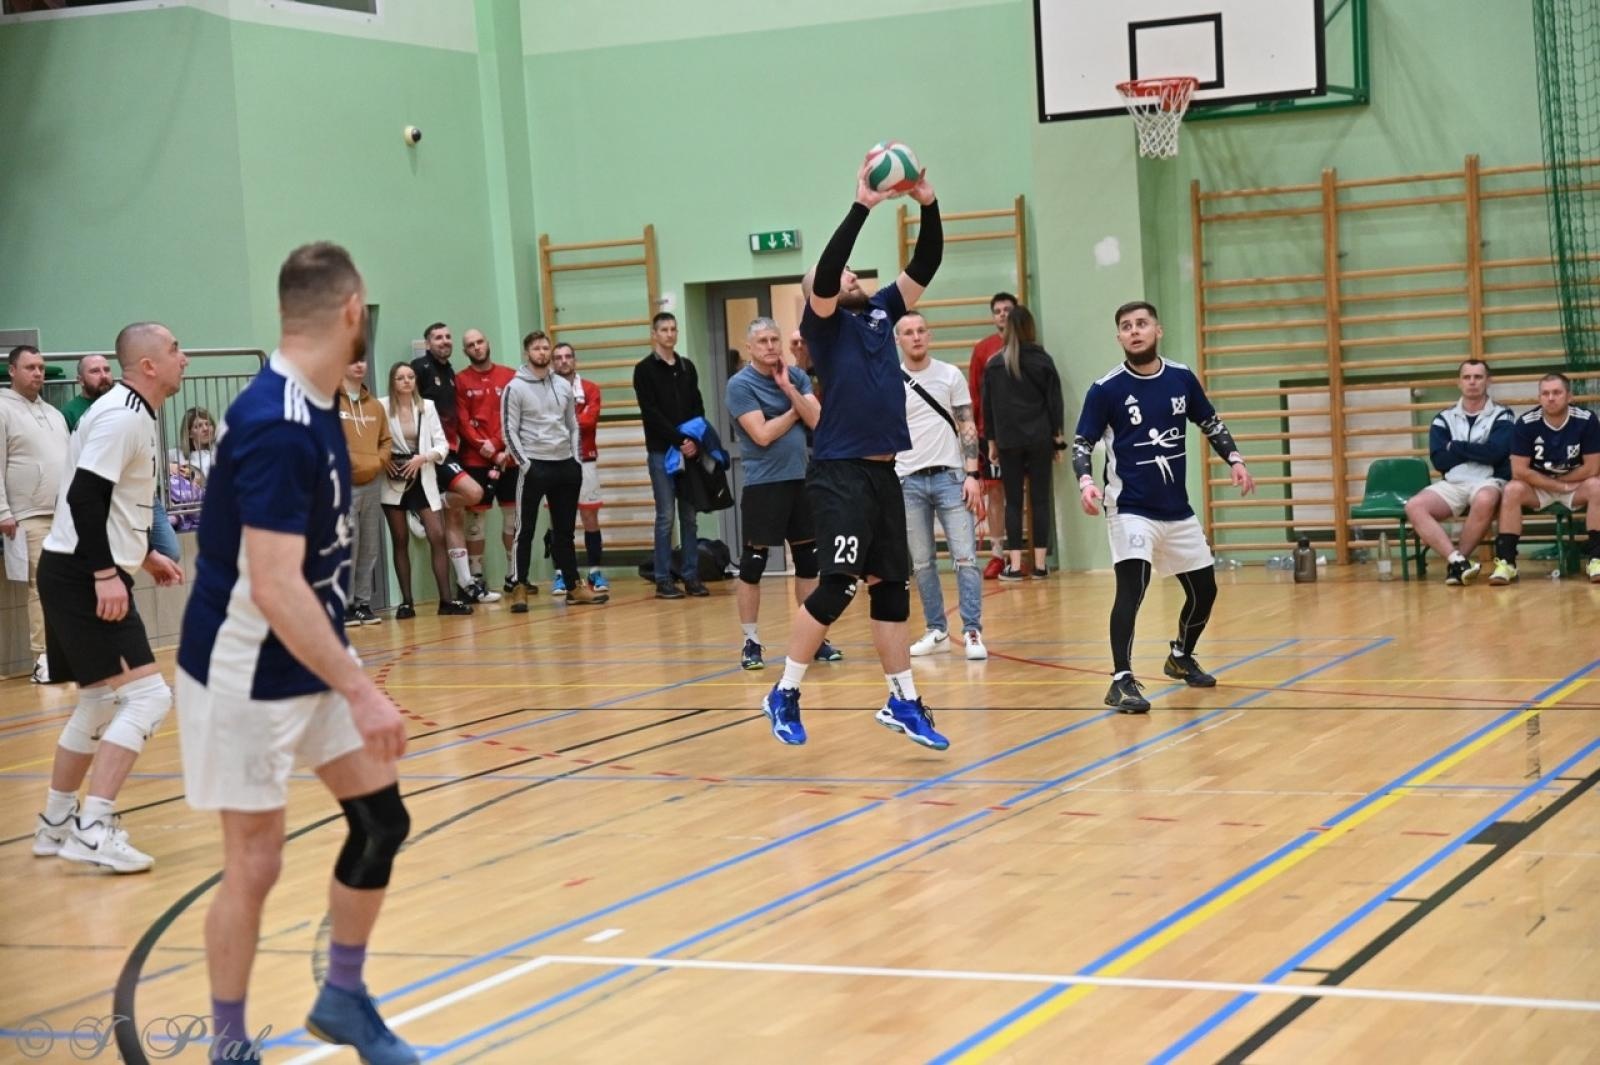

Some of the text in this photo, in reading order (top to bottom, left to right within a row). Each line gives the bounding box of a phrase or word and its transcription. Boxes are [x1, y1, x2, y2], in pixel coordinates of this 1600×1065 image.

[1128, 405, 1142, 425] 3
[1534, 444, 1544, 460] 2
[834, 534, 859, 564] 23
